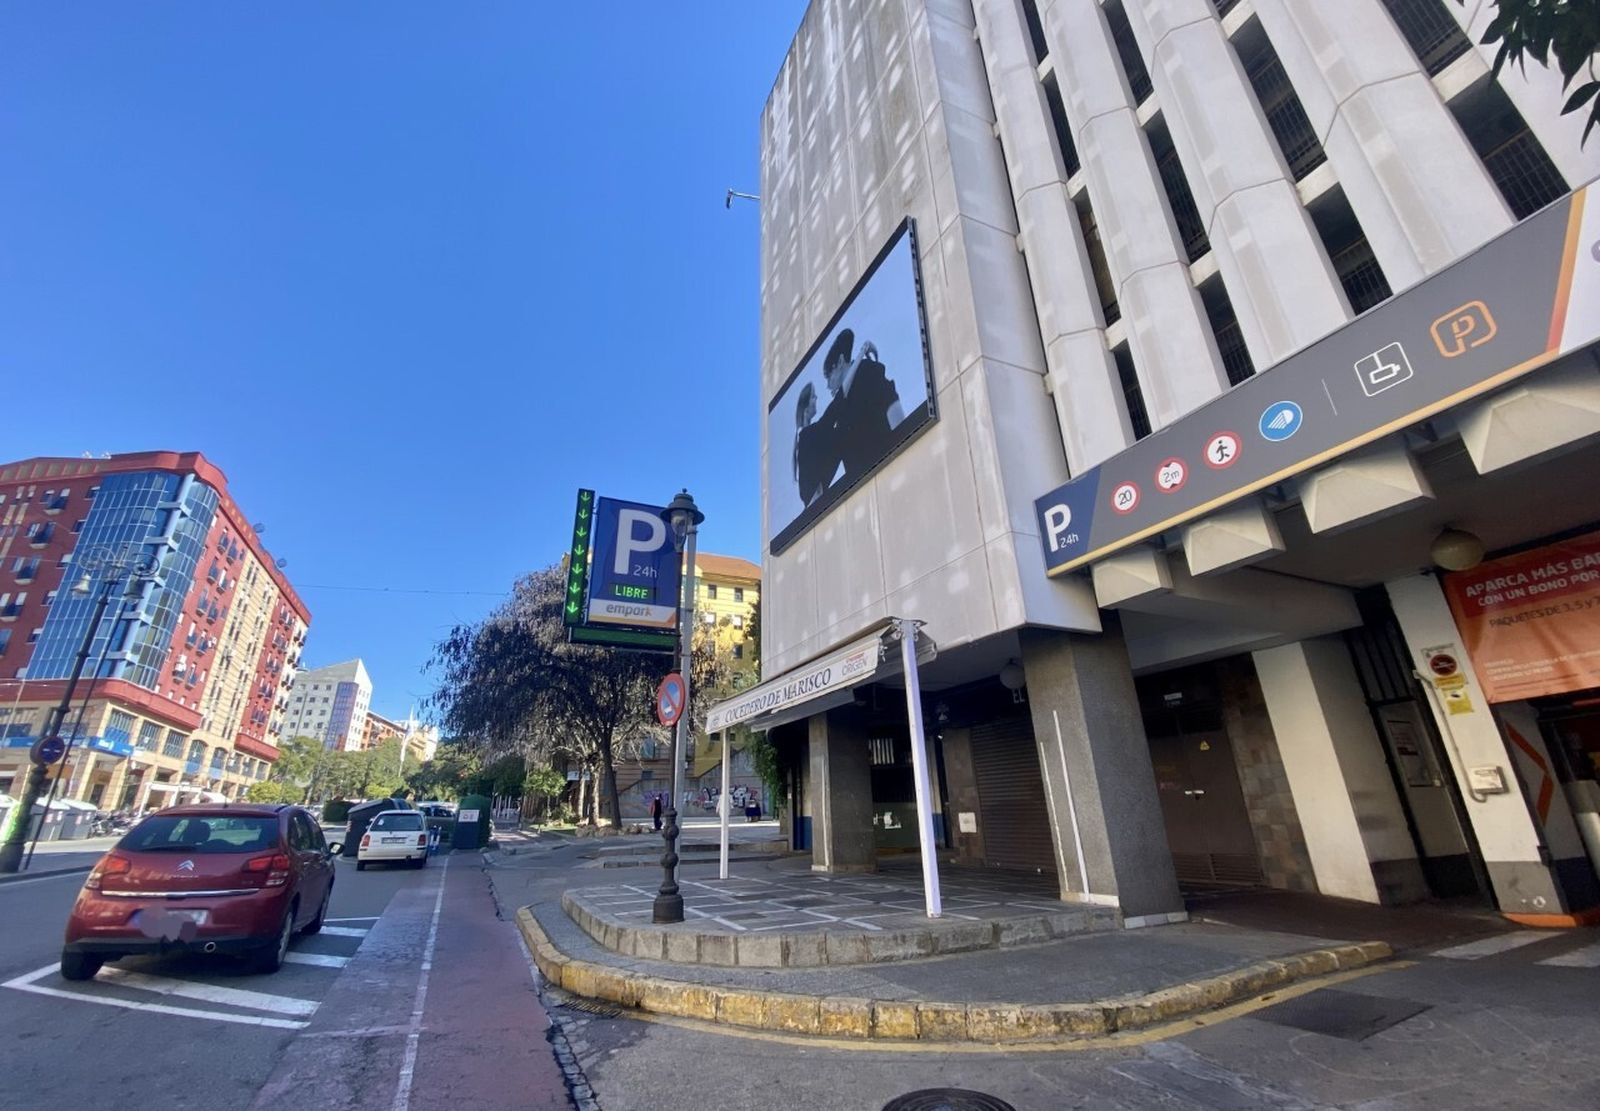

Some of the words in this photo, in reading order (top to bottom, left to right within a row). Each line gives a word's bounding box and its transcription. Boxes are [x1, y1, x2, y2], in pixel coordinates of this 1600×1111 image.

[1163, 469, 1180, 483] 2m
[1117, 489, 1132, 505] 20
[1044, 503, 1071, 552] P
[614, 508, 667, 575] P
[1060, 532, 1079, 549] 24h
[633, 564, 658, 579] 24h
[1467, 573, 1528, 597] APARCA
[1532, 562, 1568, 581] MÁS
[614, 584, 649, 599] LIBRE
[1478, 593, 1503, 606] CON
[1506, 588, 1525, 600] UN
[1529, 578, 1567, 594] BONO
[1570, 570, 1599, 585] POR
[606, 602, 653, 617] empark
[1490, 610, 1544, 626] PAQUETES
[1546, 607, 1560, 616] DE
[724, 697, 767, 723] COCEDERO
[766, 690, 782, 707] DE
[782, 668, 832, 704] MARISCO
